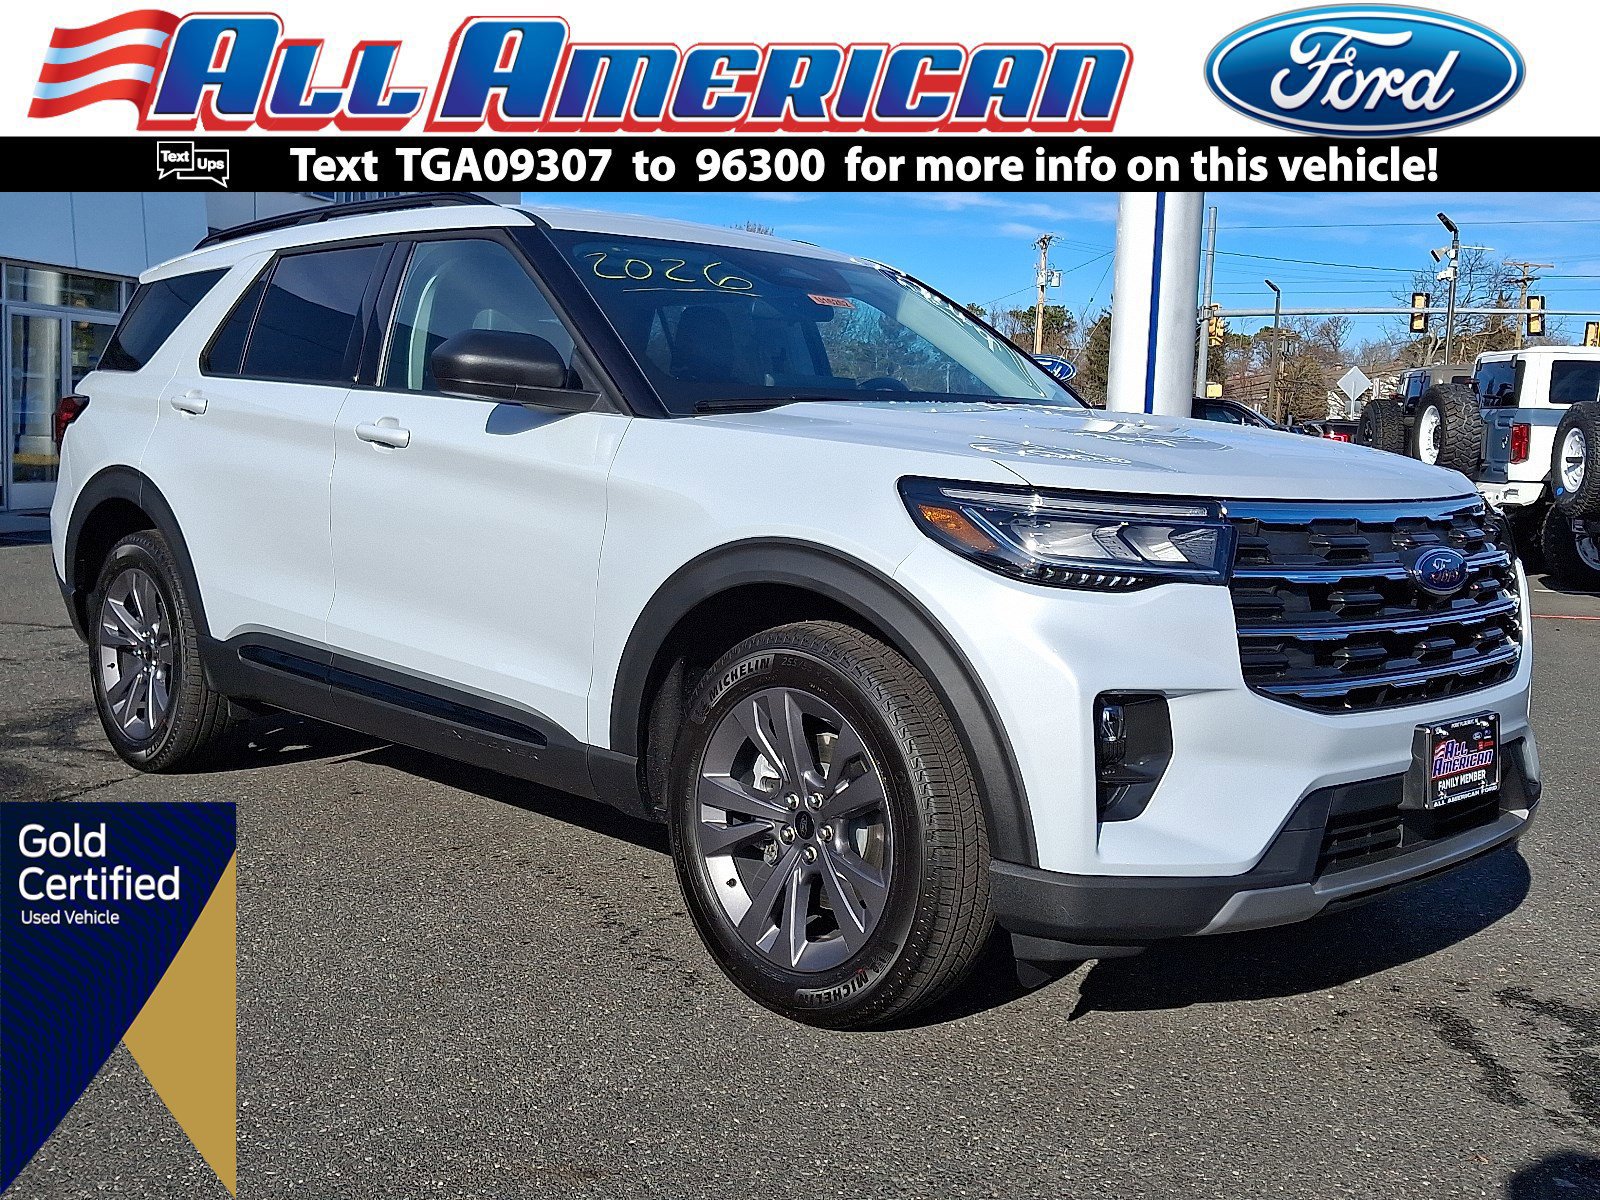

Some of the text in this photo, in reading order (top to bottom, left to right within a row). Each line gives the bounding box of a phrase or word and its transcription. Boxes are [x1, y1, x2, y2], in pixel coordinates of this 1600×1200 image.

[584, 252, 753, 290] 2026
[709, 657, 771, 701] MICHELIN
[1445, 738, 1469, 759] ALL
[1431, 749, 1494, 779] AMERICAN
[1438, 769, 1487, 791] FAMILY MEMBER
[1434, 800, 1447, 808] ALL
[1447, 789, 1480, 804] AMERICAN
[798, 969, 869, 1005] MICHELIN
